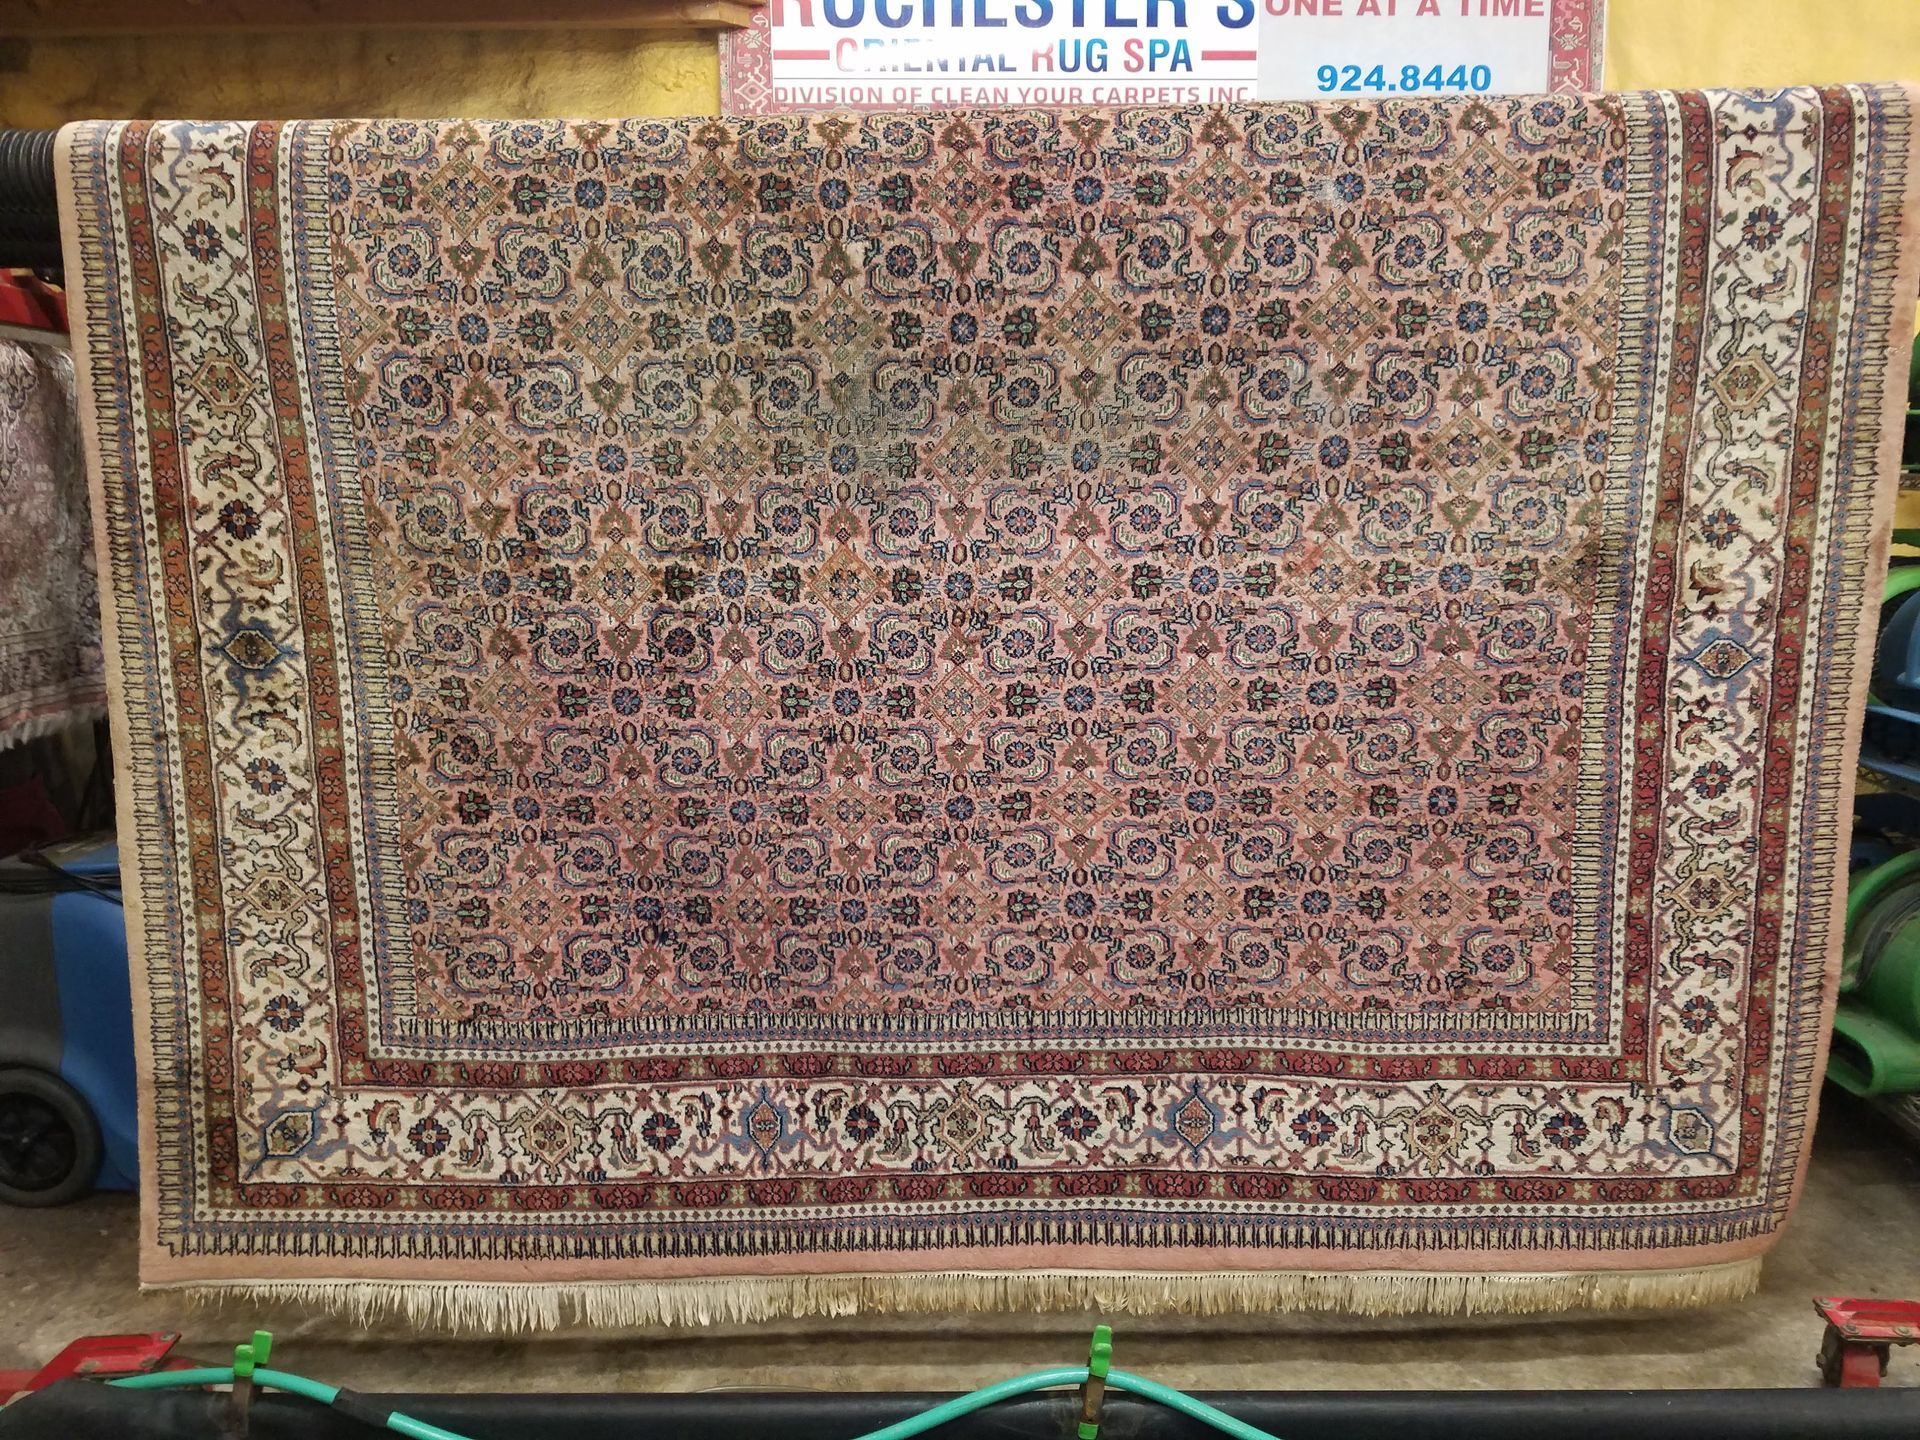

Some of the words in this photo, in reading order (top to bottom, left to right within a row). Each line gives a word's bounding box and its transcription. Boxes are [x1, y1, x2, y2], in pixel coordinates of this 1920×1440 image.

[1123, 38, 1193, 72] SPA
[1316, 64, 1492, 92] 924.8440
[774, 87, 882, 104] DIVISION
[893, 87, 923, 104] OF
[931, 87, 1008, 104] CLEAN
[1018, 87, 1083, 104] YOUR
[1092, 87, 1200, 104] CARPETS
[1209, 87, 1256, 103] INC.
